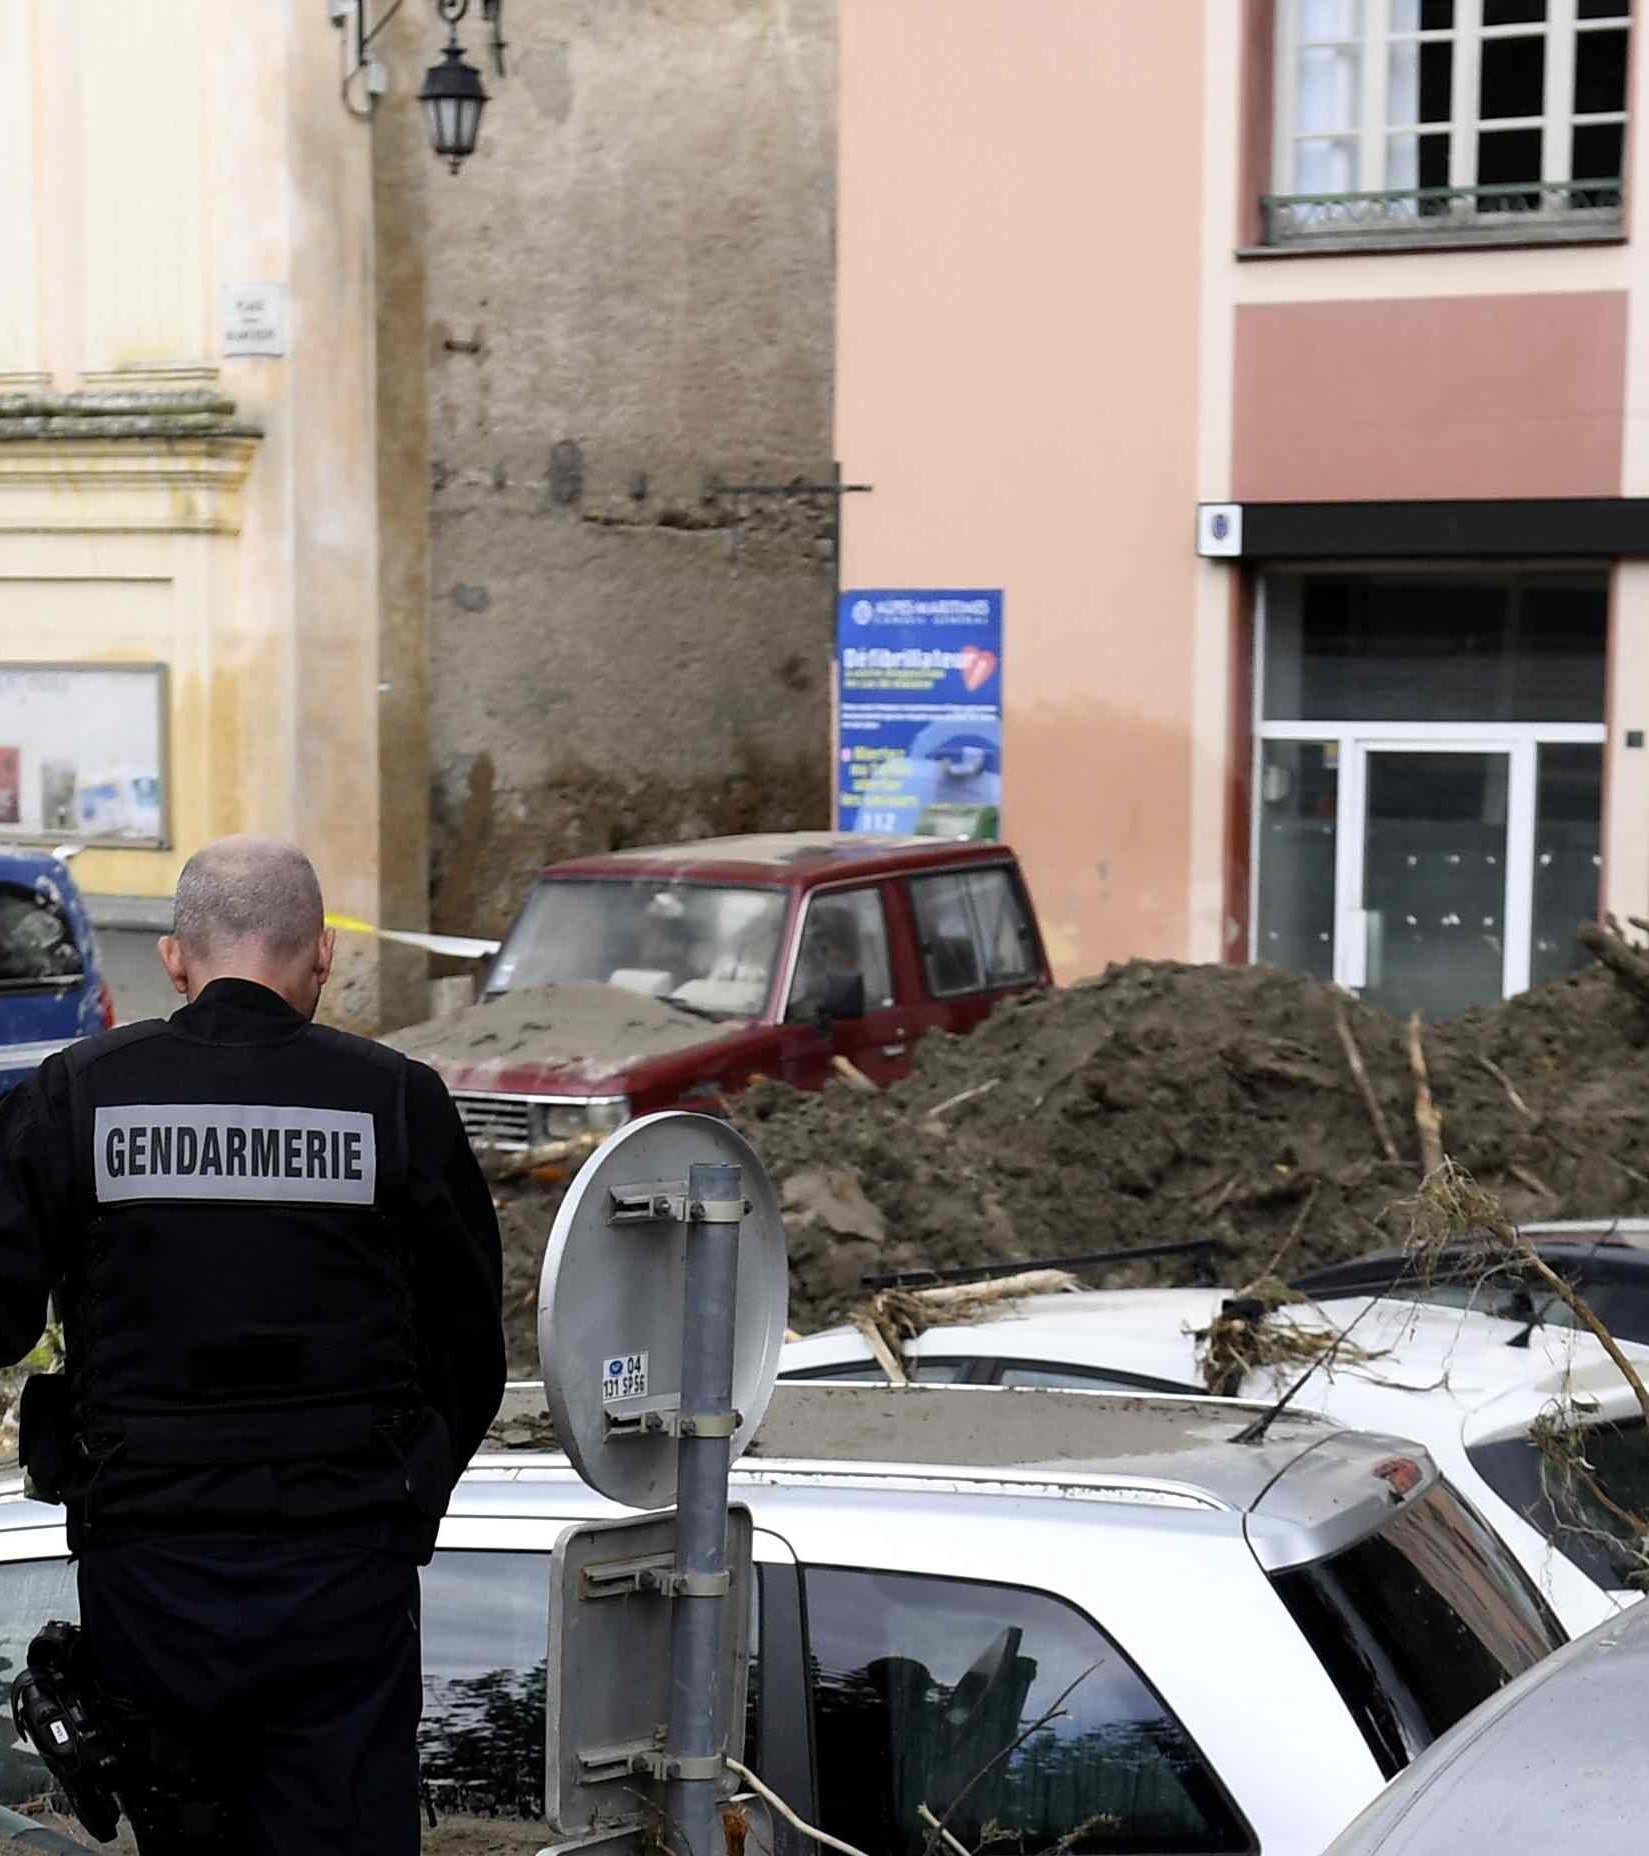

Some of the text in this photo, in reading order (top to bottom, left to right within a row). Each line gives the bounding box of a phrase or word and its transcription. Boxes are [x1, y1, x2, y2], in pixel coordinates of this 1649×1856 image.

[106, 1126, 362, 1180] GENDARMERIE
[627, 1355, 641, 1374] 04
[603, 1379, 619, 1397] 131
